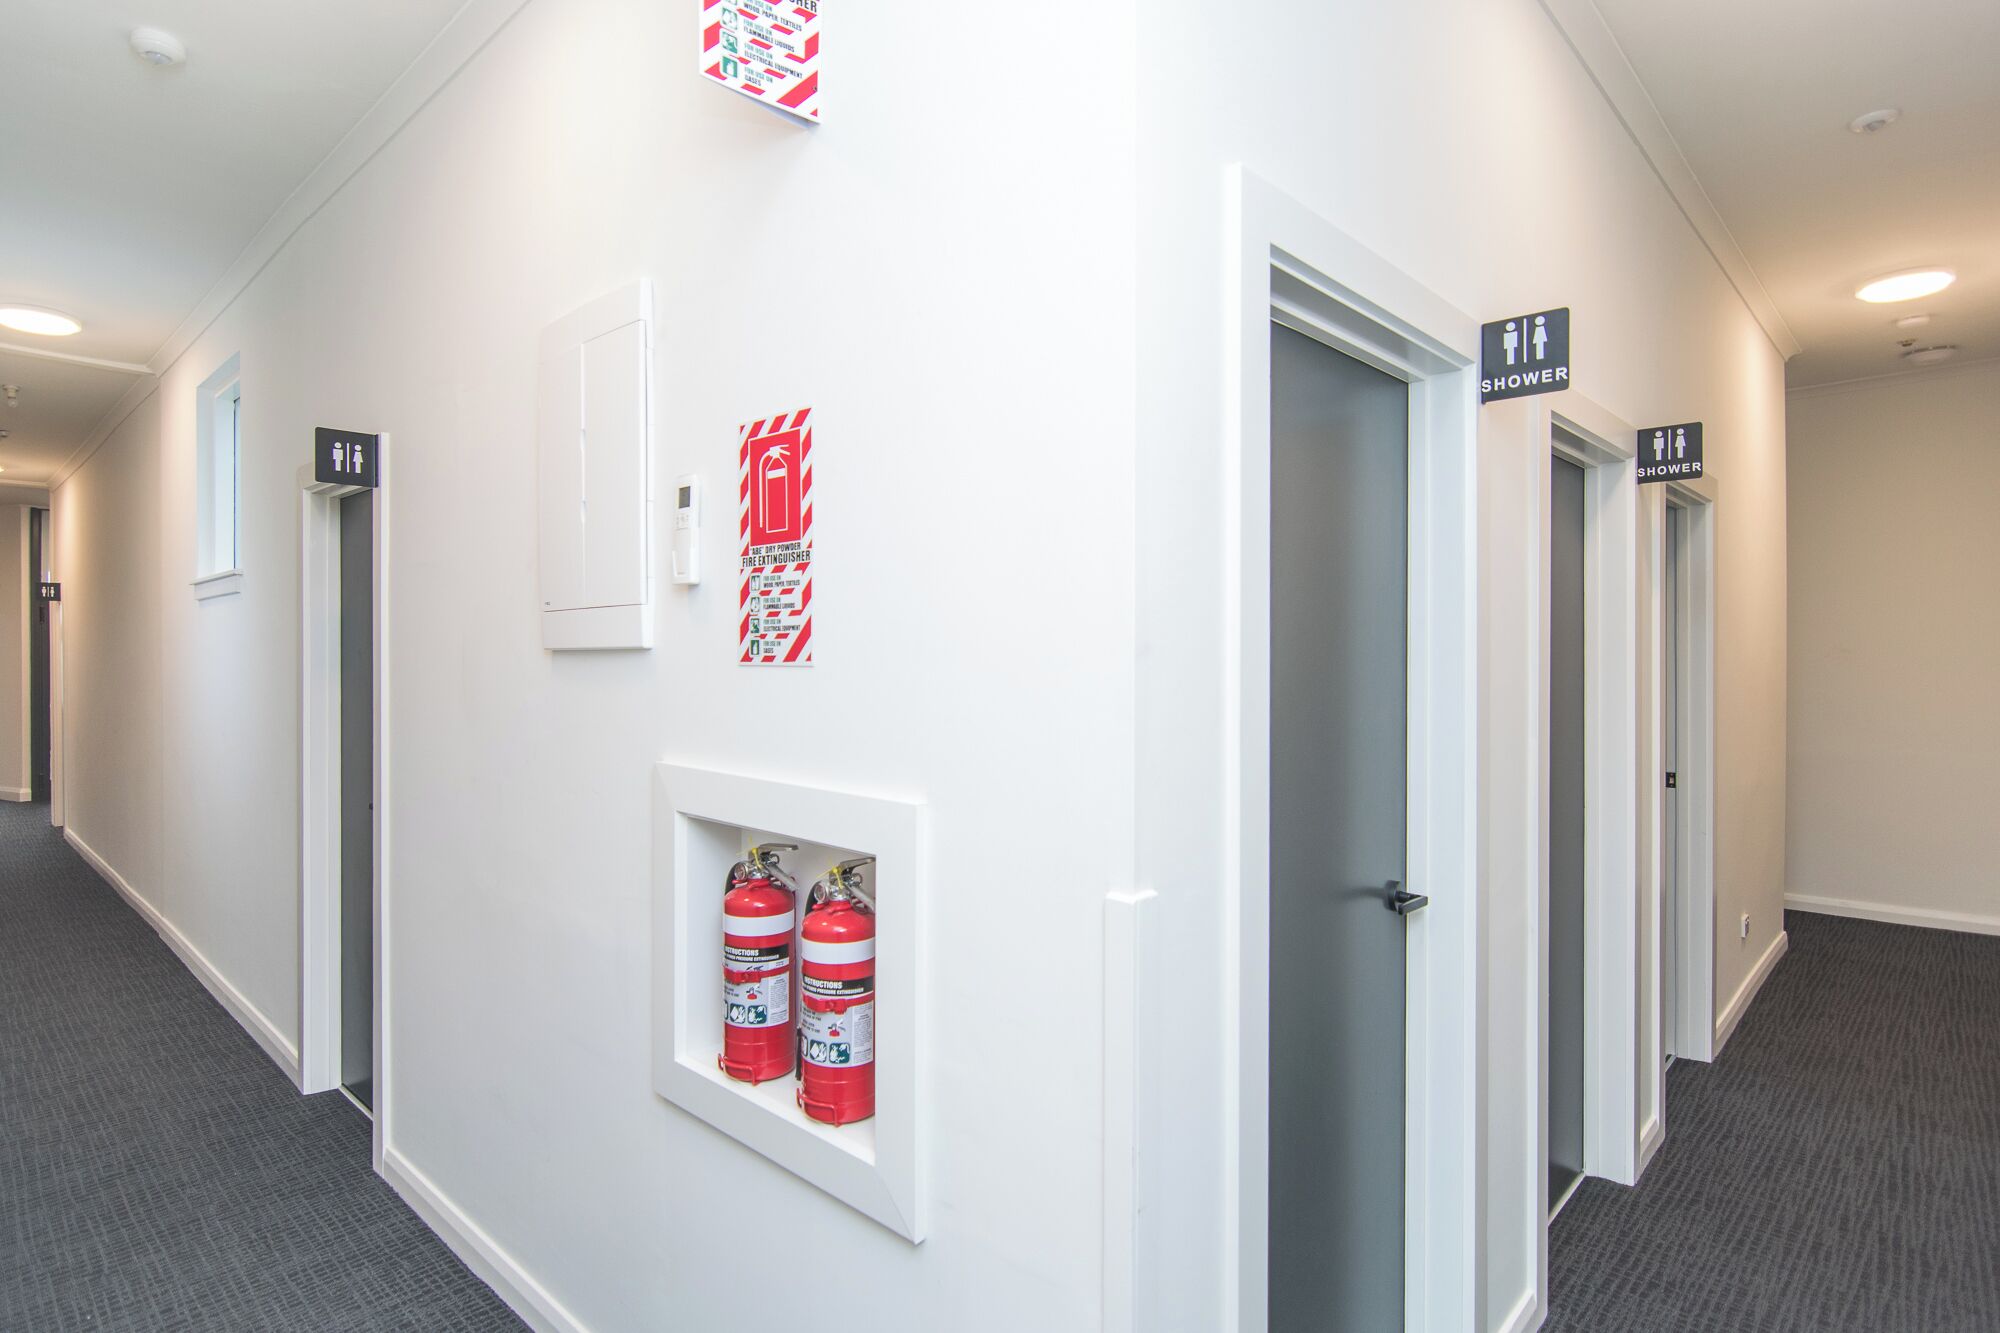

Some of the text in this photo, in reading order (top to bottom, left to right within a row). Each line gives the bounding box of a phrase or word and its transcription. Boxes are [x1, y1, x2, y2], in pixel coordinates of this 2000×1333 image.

[744, 50, 803, 79] ELECTRICAL EQUIPMENT
[1481, 366, 1568, 393] SHOWER
[1637, 462, 1702, 478] SHOWER
[765, 545, 776, 554] DRY
[777, 542, 801, 553] POWDER
[742, 550, 811, 567] FIRE EXTINGUISHER
